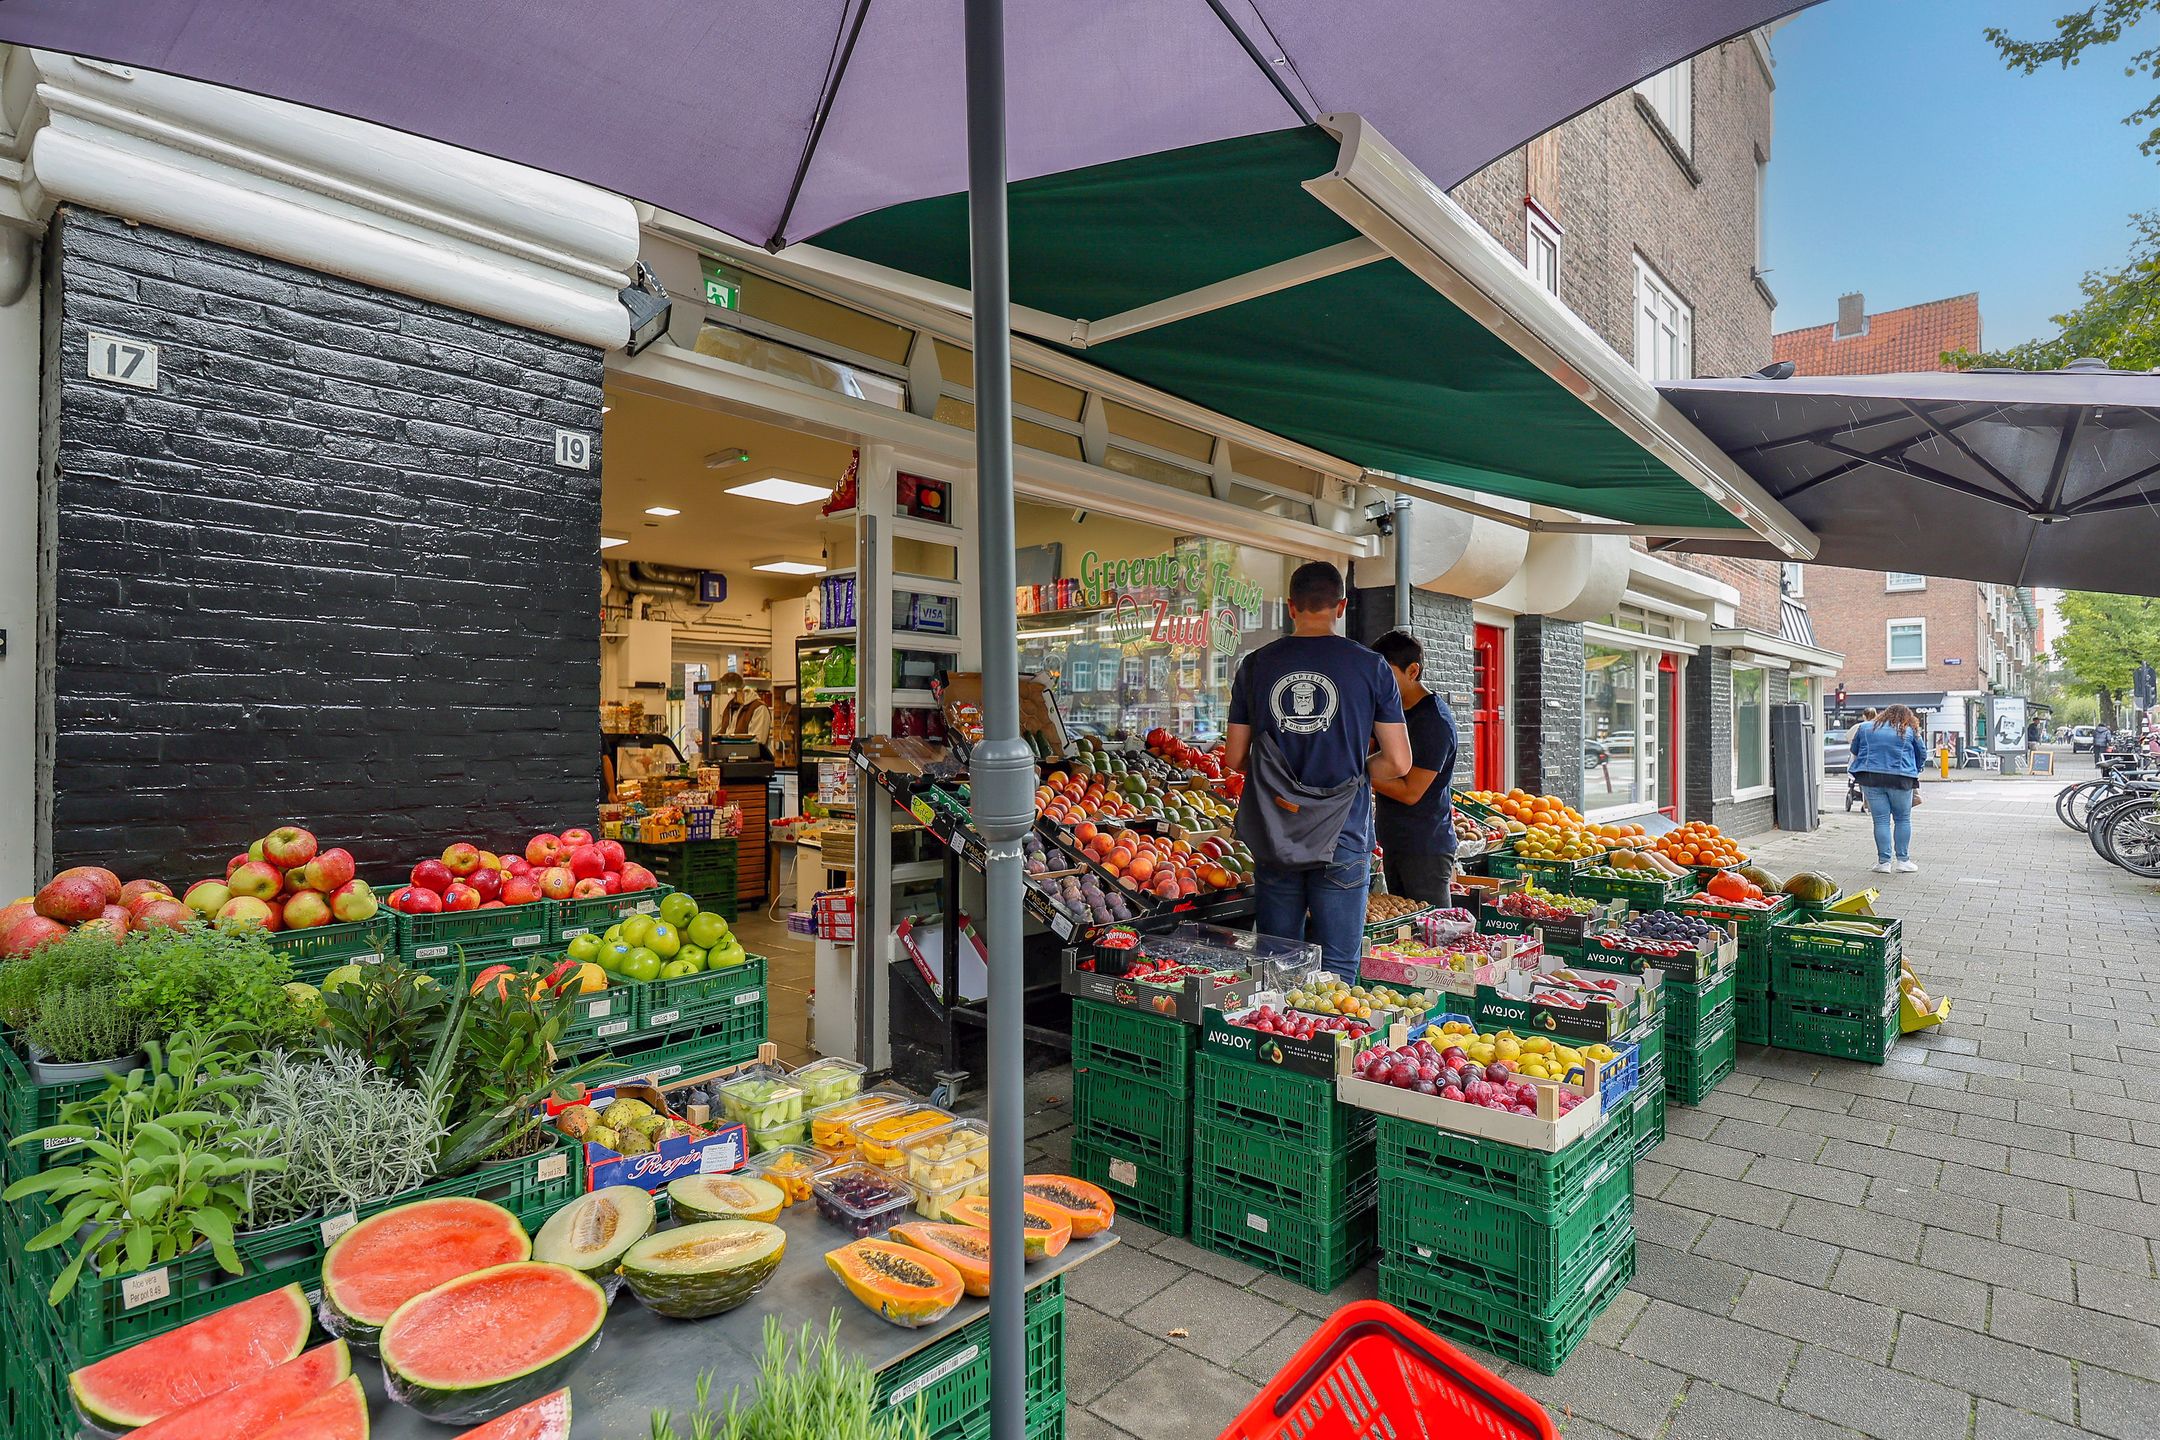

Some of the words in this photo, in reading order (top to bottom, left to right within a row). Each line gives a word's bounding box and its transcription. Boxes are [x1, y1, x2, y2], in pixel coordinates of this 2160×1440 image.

[107, 343, 145, 379] 17
[562, 435, 584, 464] 19
[1080, 550, 1180, 606] Groente
[1185, 553, 1207, 592] &
[1212, 562, 1264, 617] Fruit
[922, 608, 943, 620] VISA
[1150, 599, 1210, 649] Zuid
[1286, 674, 1325, 683] KAPTEIN
[1289, 722, 1302, 730] BIKE
[1304, 722, 1320, 730] SHOP
[965, 842, 987, 862] PASCH
[1027, 889, 1057, 917] PASCHA
[627, 1148, 704, 1179] Regin
[145, 1276, 157, 1284] vera
